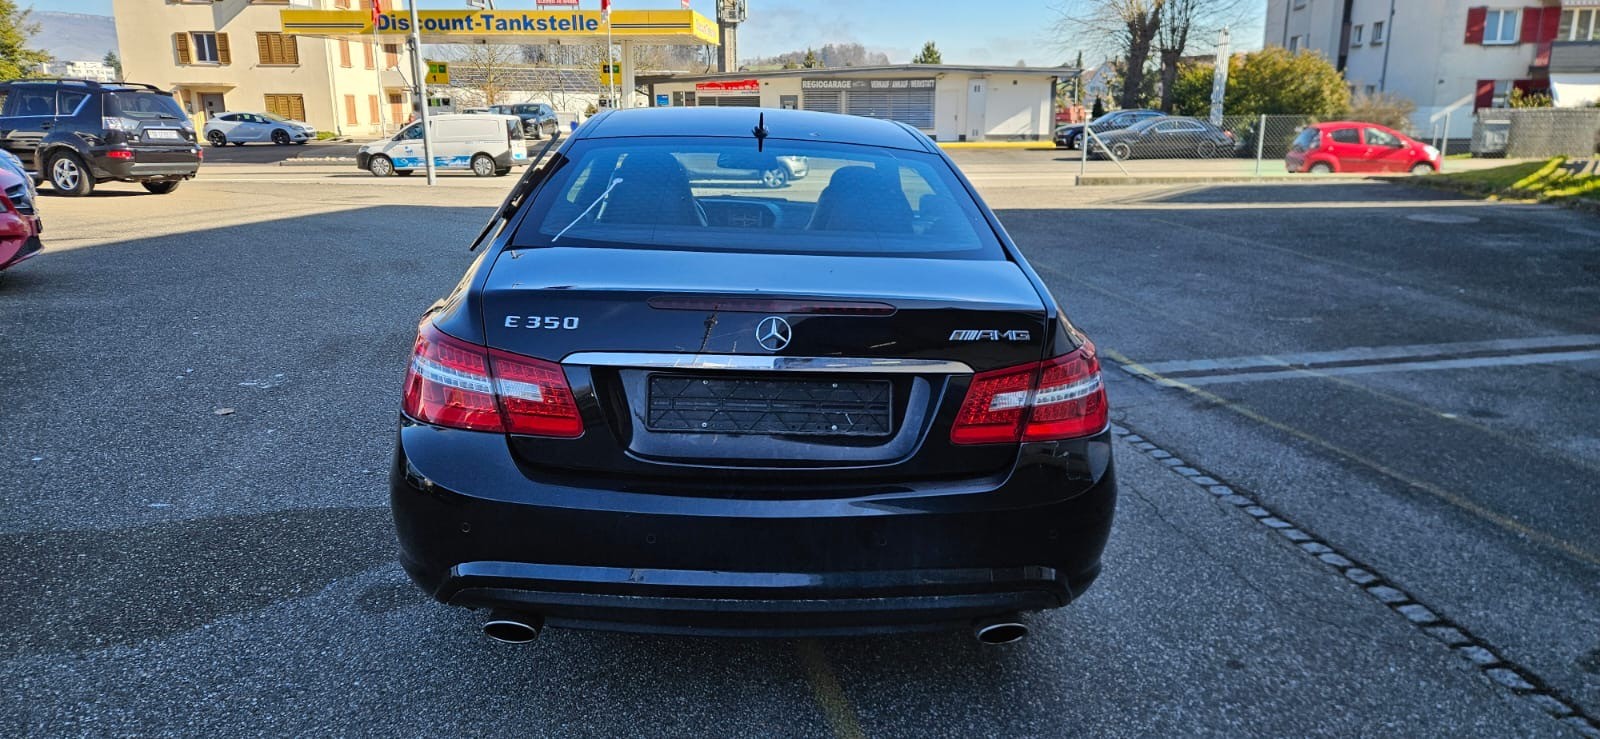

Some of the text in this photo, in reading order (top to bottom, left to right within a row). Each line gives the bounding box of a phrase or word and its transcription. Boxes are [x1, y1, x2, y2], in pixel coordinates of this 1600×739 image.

[802, 80, 852, 88] REGIOGARAGE
[504, 315, 580, 330] E 350
[975, 329, 1031, 341] AMG
